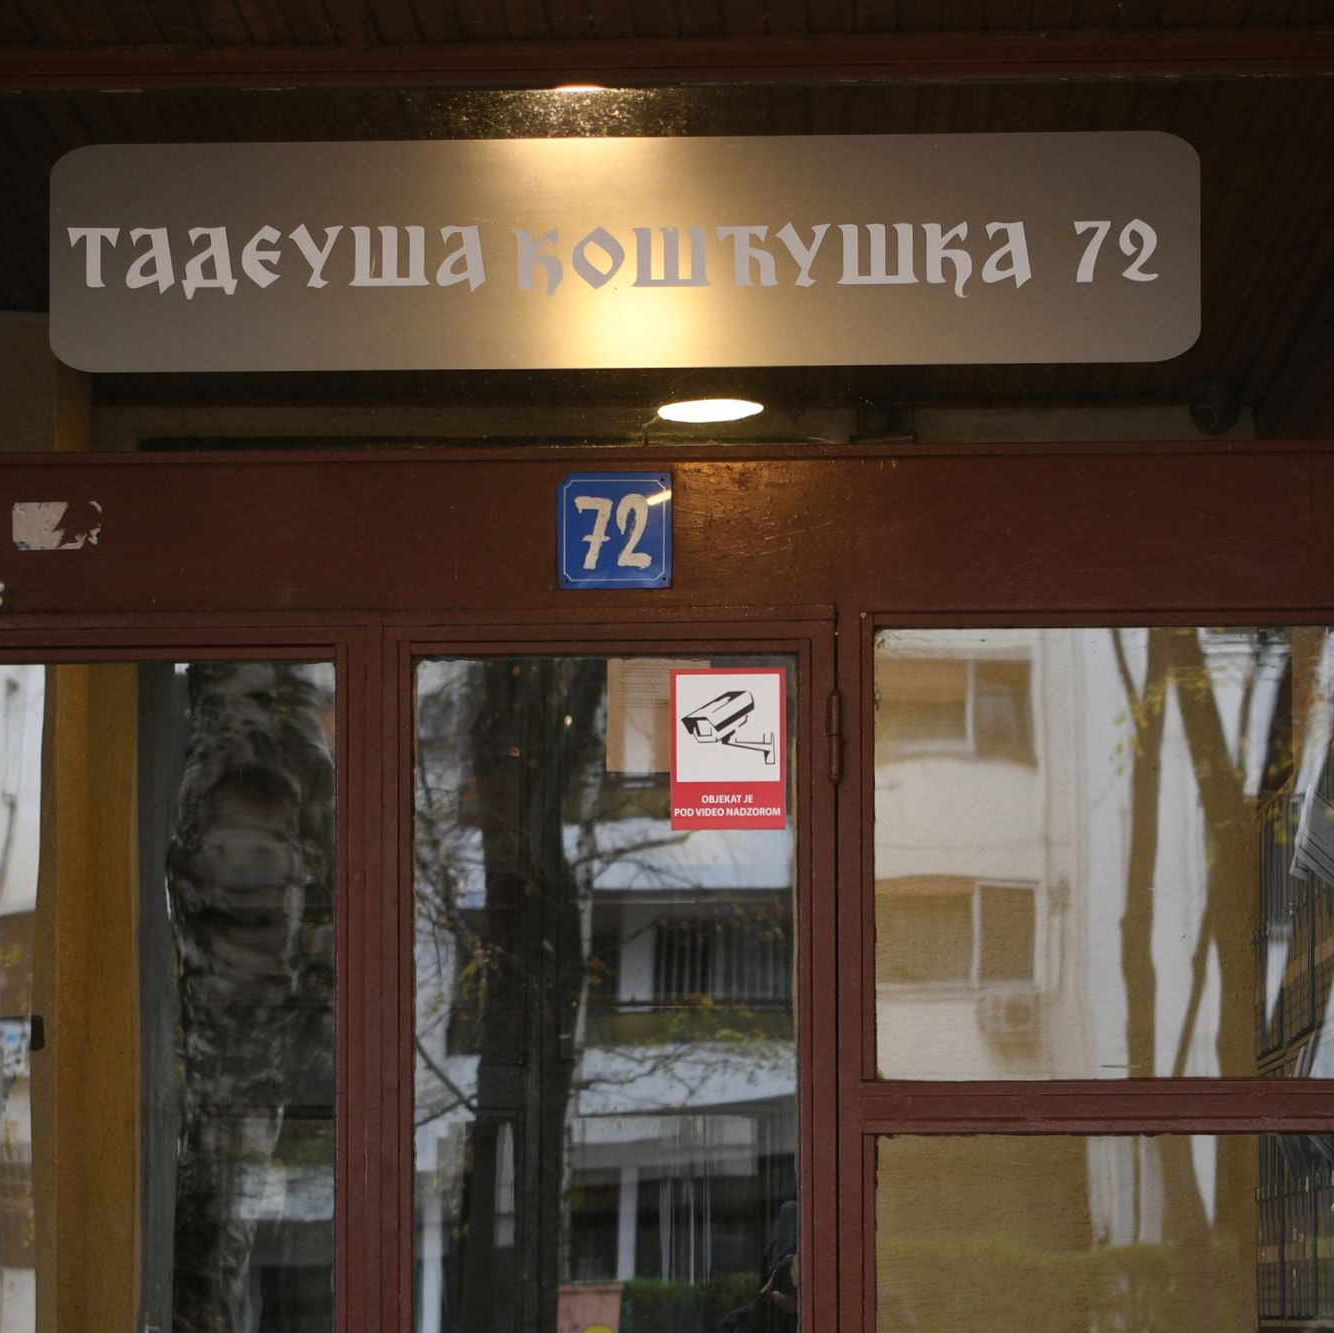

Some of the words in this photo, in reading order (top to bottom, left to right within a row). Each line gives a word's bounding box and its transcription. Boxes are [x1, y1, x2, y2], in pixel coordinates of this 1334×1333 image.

[515, 220, 1032, 298] КОШЋУШКА
[1072, 217, 1161, 284] 72
[574, 493, 652, 570] 72
[674, 808, 694, 817] POD
[695, 808, 724, 817] VIDEO
[726, 807, 781, 817] NADZOROM
[701, 794, 742, 804] OBJEKAT
[743, 794, 754, 804] JE
